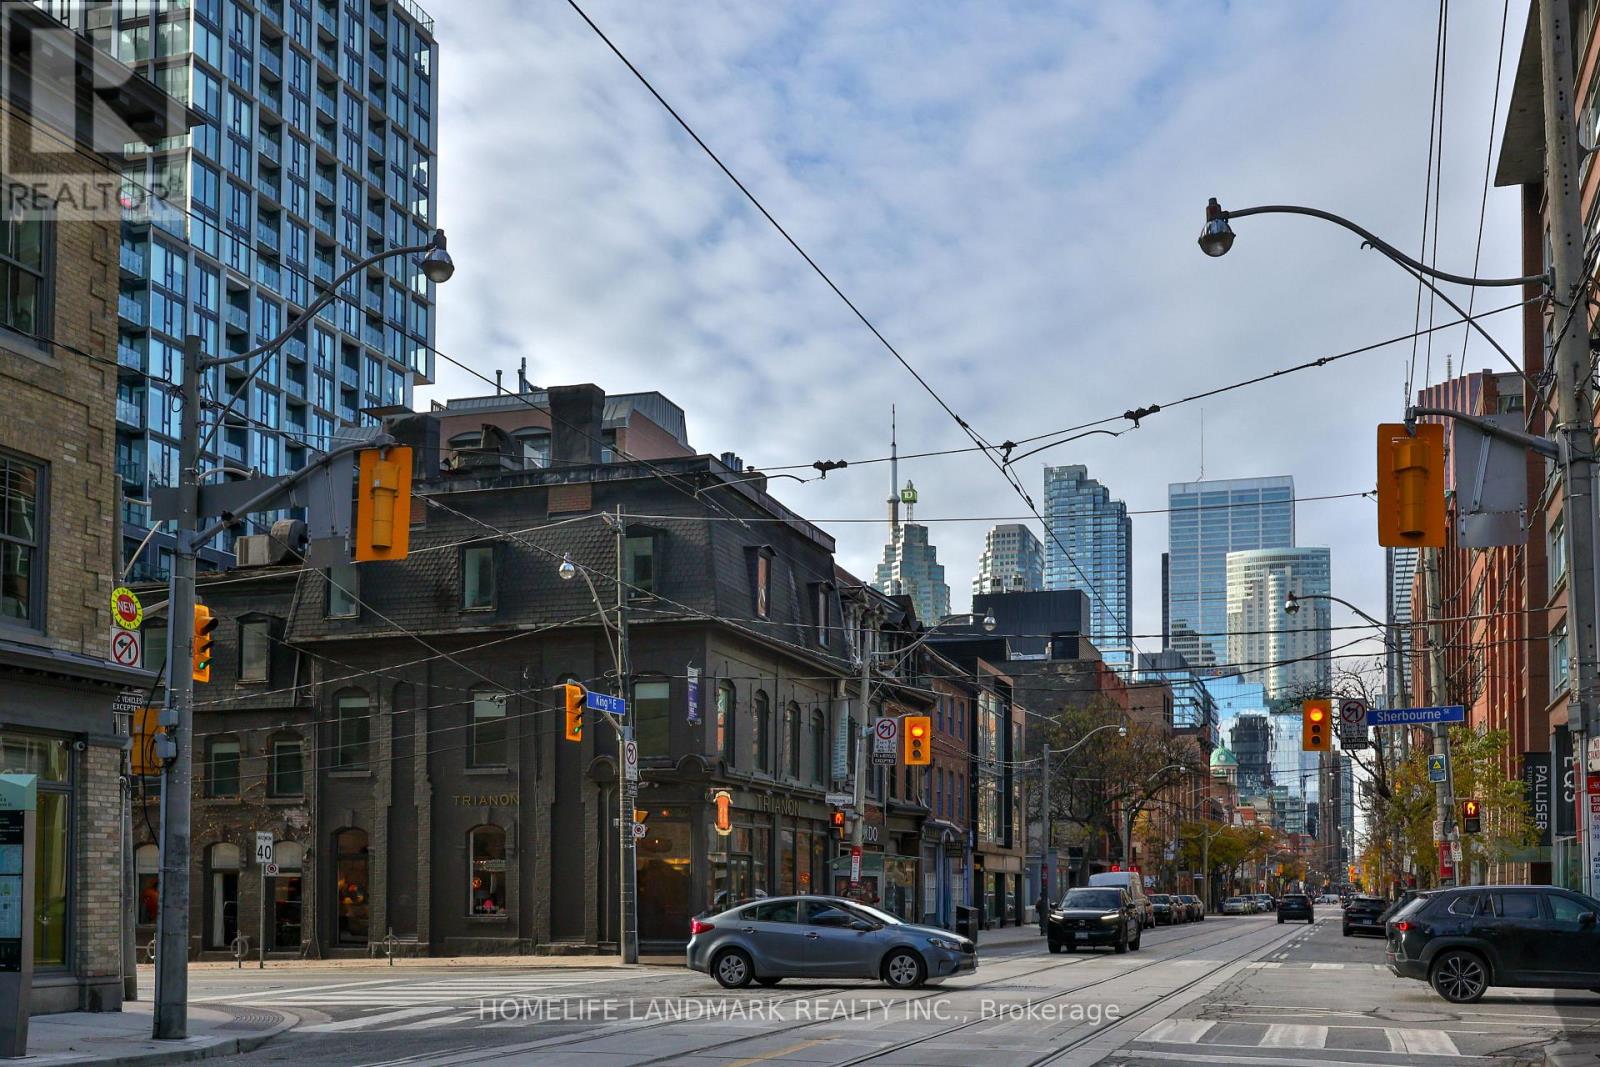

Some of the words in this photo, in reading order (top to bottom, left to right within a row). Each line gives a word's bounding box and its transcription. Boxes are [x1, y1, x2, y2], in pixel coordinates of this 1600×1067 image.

[117, 600, 136, 615] NEW
[595, 695, 608, 710] King
[612, 699, 617, 710] E
[1376, 710, 1441, 722] Sherbourne
[451, 793, 519, 806] TRIANON
[756, 794, 801, 816] TRIANON
[1535, 765, 1548, 830] PALLISER
[257, 844, 272, 860] 40
